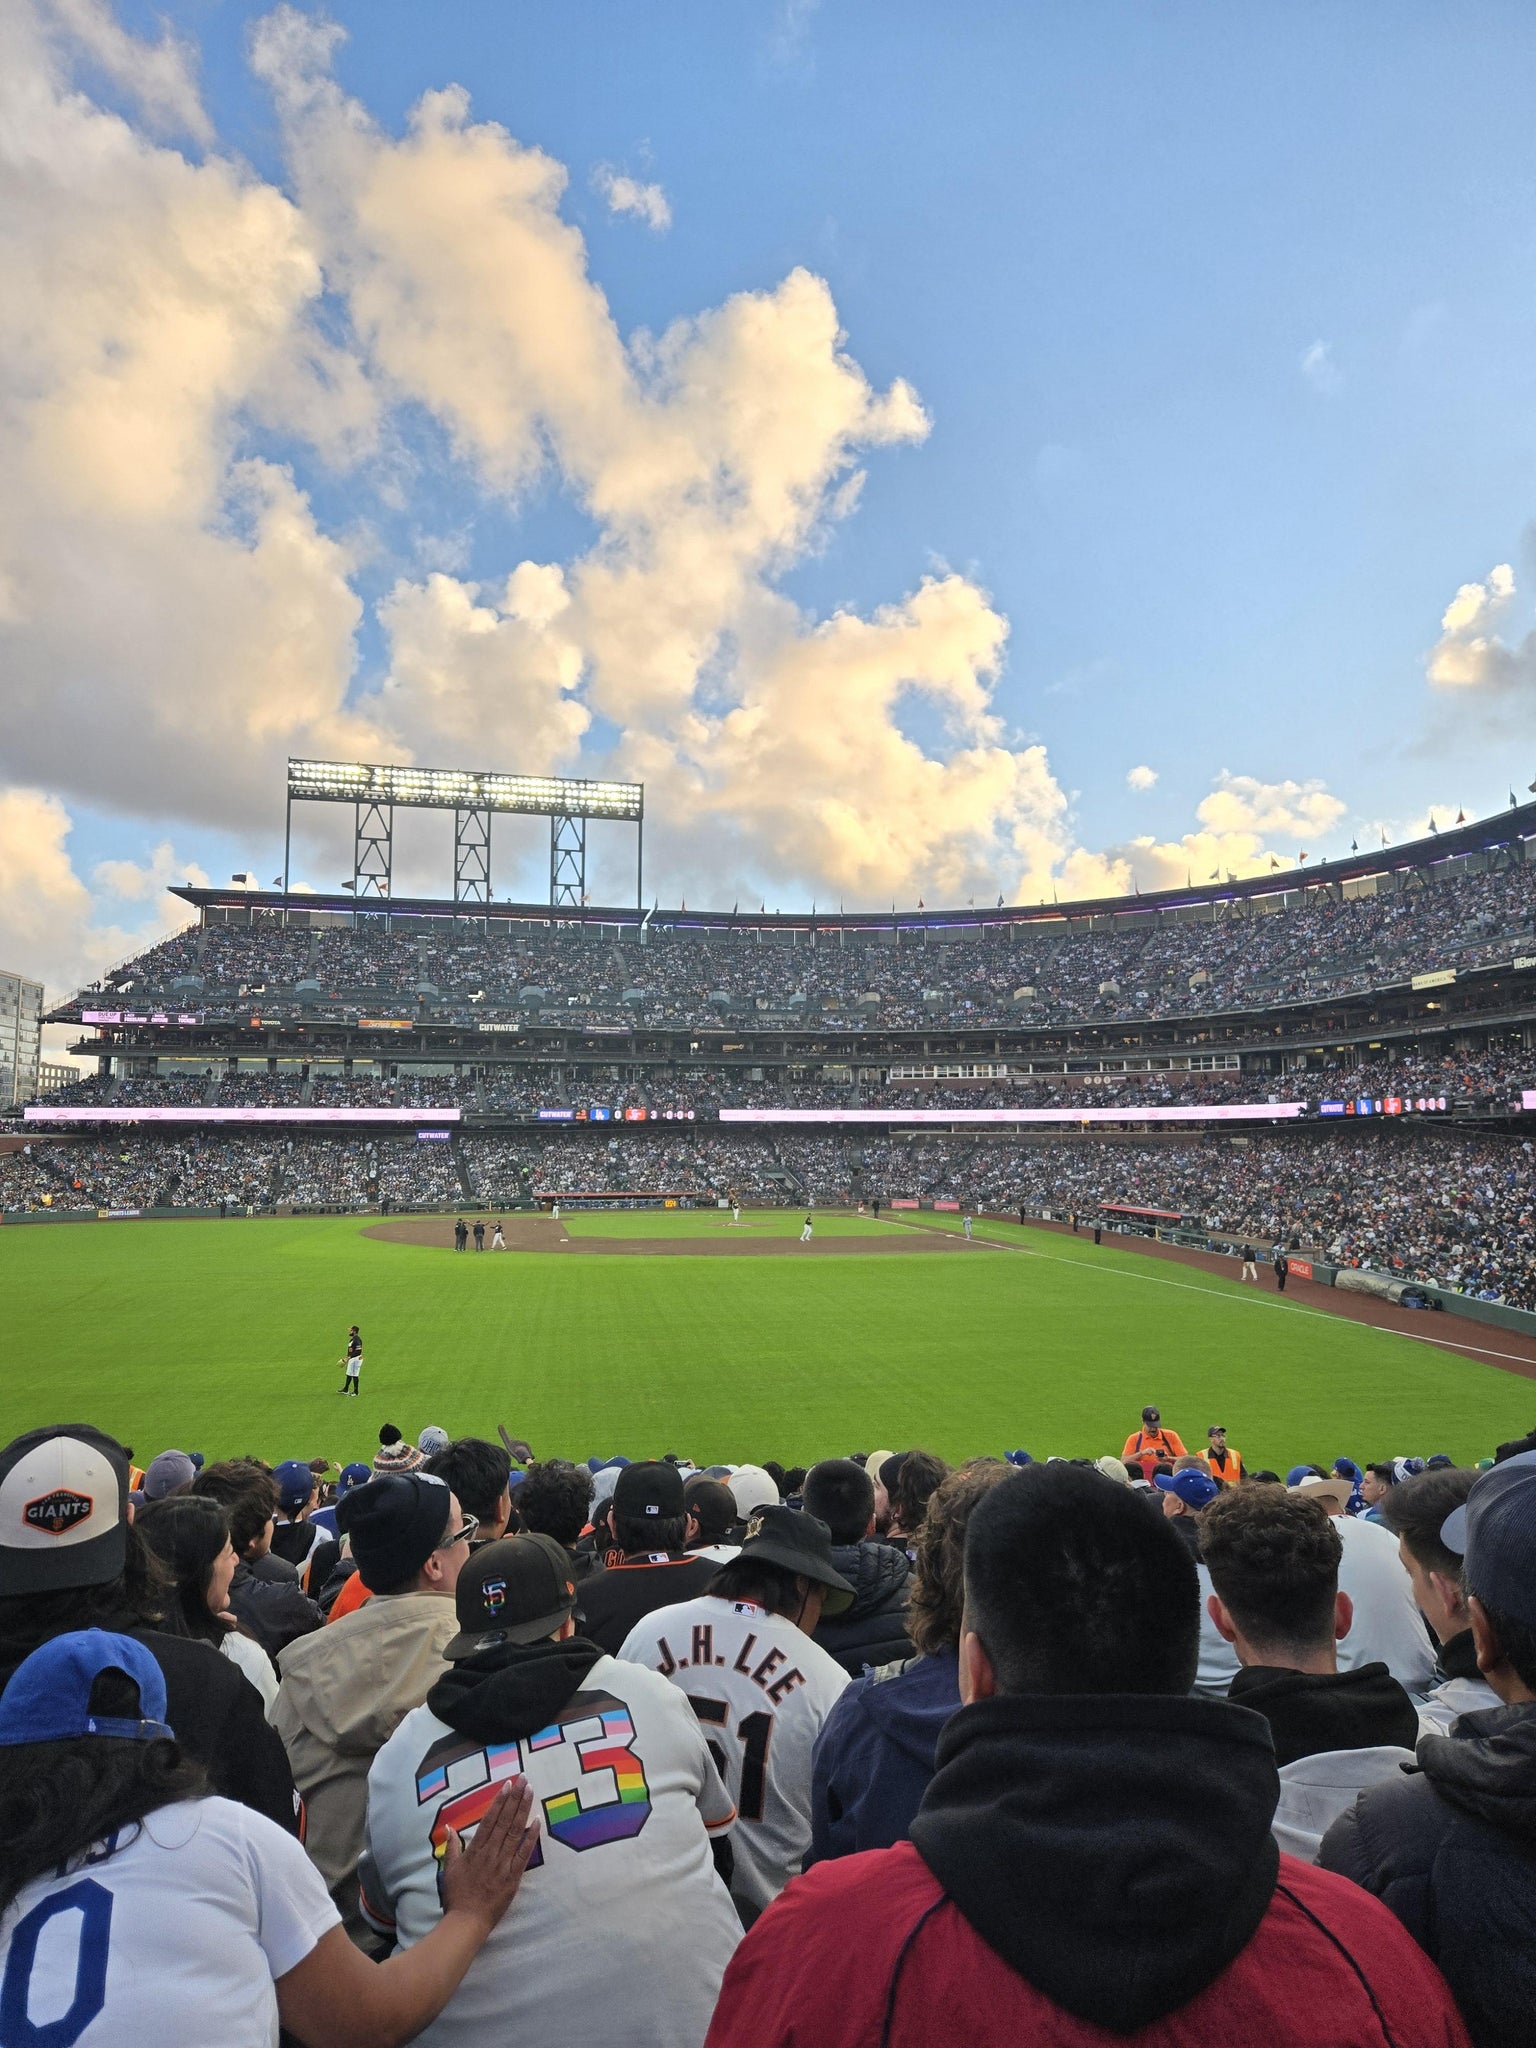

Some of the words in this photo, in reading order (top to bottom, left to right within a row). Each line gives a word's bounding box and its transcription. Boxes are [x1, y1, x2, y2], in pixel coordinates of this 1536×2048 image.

[479, 1024, 519, 1032] CUTWATER
[1375, 1100, 1382, 1113] 0
[614, 1110, 622, 1120] 0
[651, 1110, 658, 1120] 3
[1290, 1262, 1309, 1275] ORACLE
[28, 1502, 90, 1518] GIANTS
[481, 1575, 507, 1617] SF
[656, 1624, 726, 1677] J.H.
[733, 1632, 807, 1707] LEE
